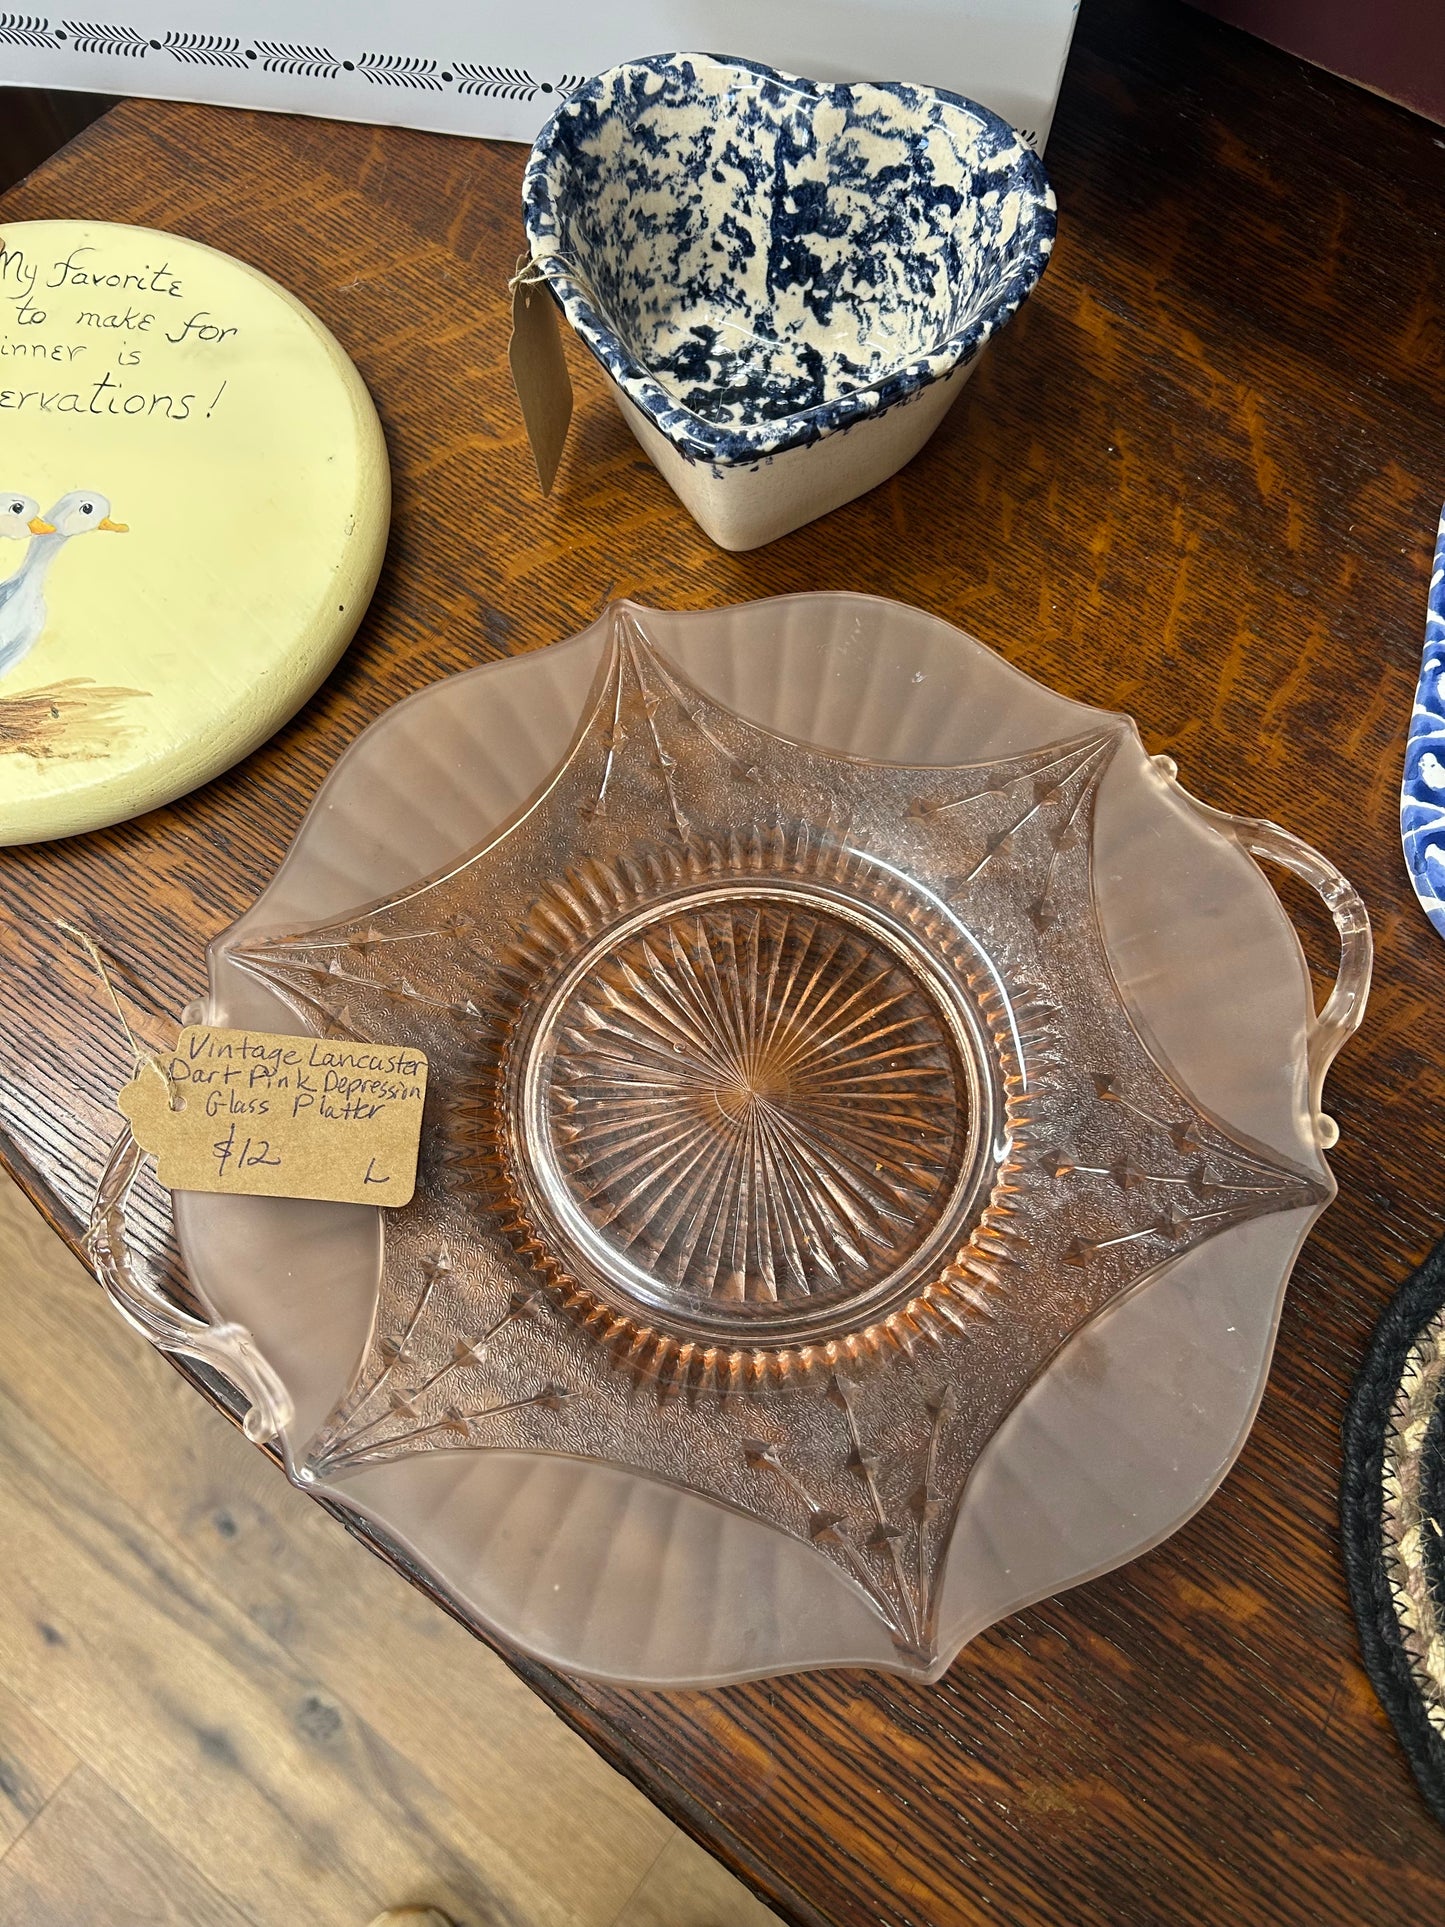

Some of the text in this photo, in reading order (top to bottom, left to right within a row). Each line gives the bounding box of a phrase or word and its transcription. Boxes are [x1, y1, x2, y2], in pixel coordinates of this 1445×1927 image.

[0, 247, 183, 300] My favorite
[16, 296, 238, 342] to make for
[0, 335, 141, 364] inner is
[0, 372, 226, 419] ervations!
[189, 1033, 303, 1074] Vintage
[169, 1057, 421, 1101] Dart Pink Depression
[206, 1089, 386, 1120] Glass Platter
[213, 1123, 281, 1176] $12
[363, 1158, 389, 1184] L
